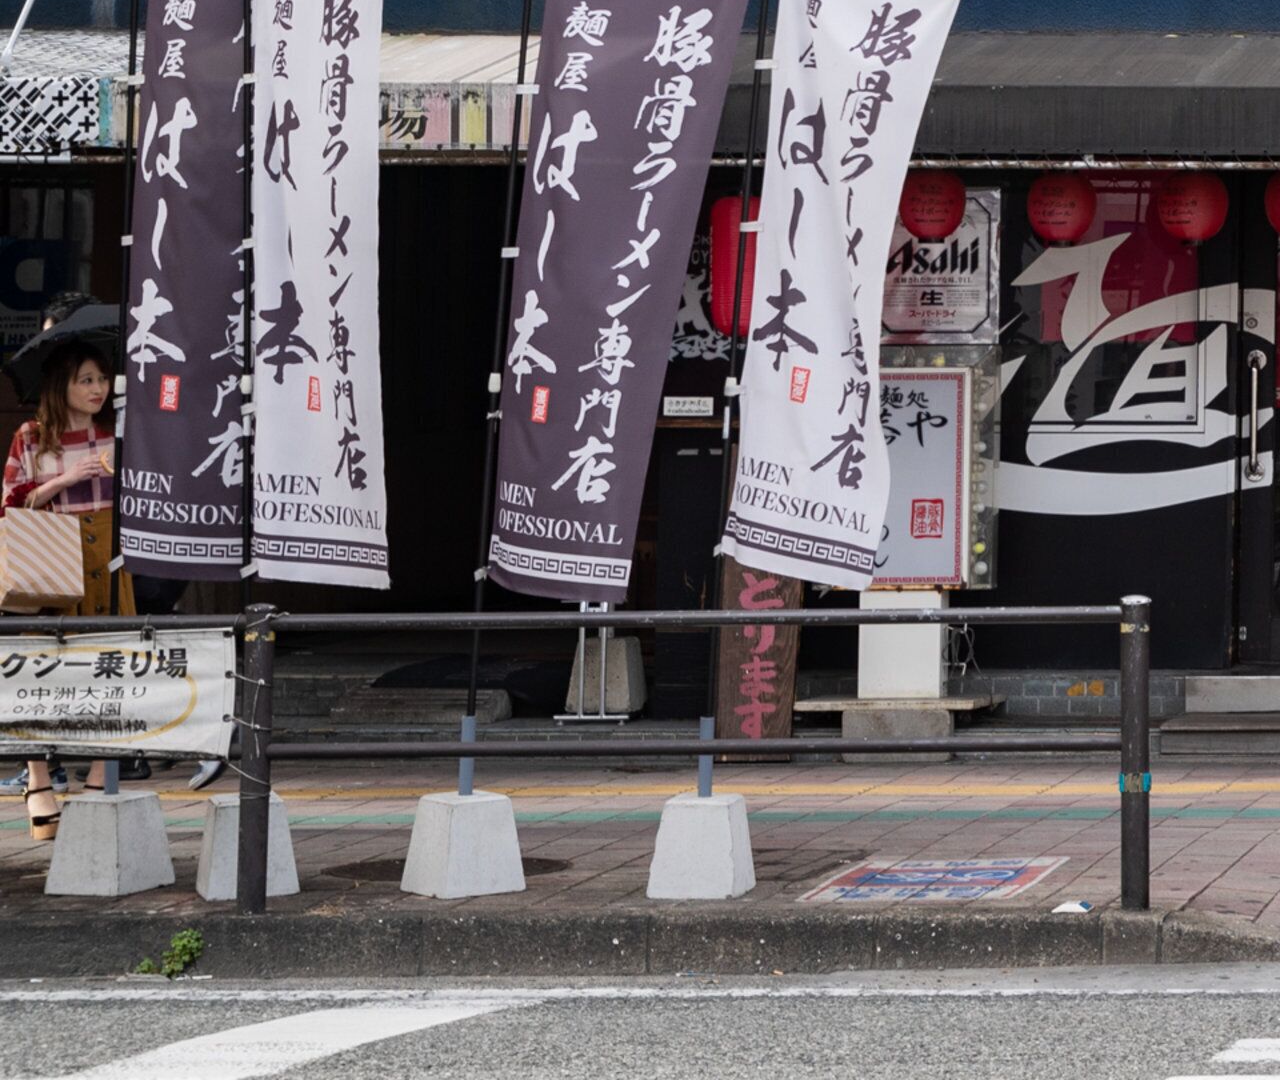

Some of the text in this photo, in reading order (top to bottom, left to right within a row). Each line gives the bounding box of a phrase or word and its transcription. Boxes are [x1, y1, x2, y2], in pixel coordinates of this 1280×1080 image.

[552, 5, 714, 504] 豚骨ラーメン専門店
[886, 236, 980, 275] Asahi
[908, 309, 957, 318] スーパードライ
[919, 290, 945, 307] 生
[120, 467, 174, 495] AMEN
[254, 472, 323, 497] AMEN
[741, 455, 793, 488] AMEN
[253, 500, 382, 531] ROFESSIONAL
[500, 508, 623, 545] OFESSIONAL
